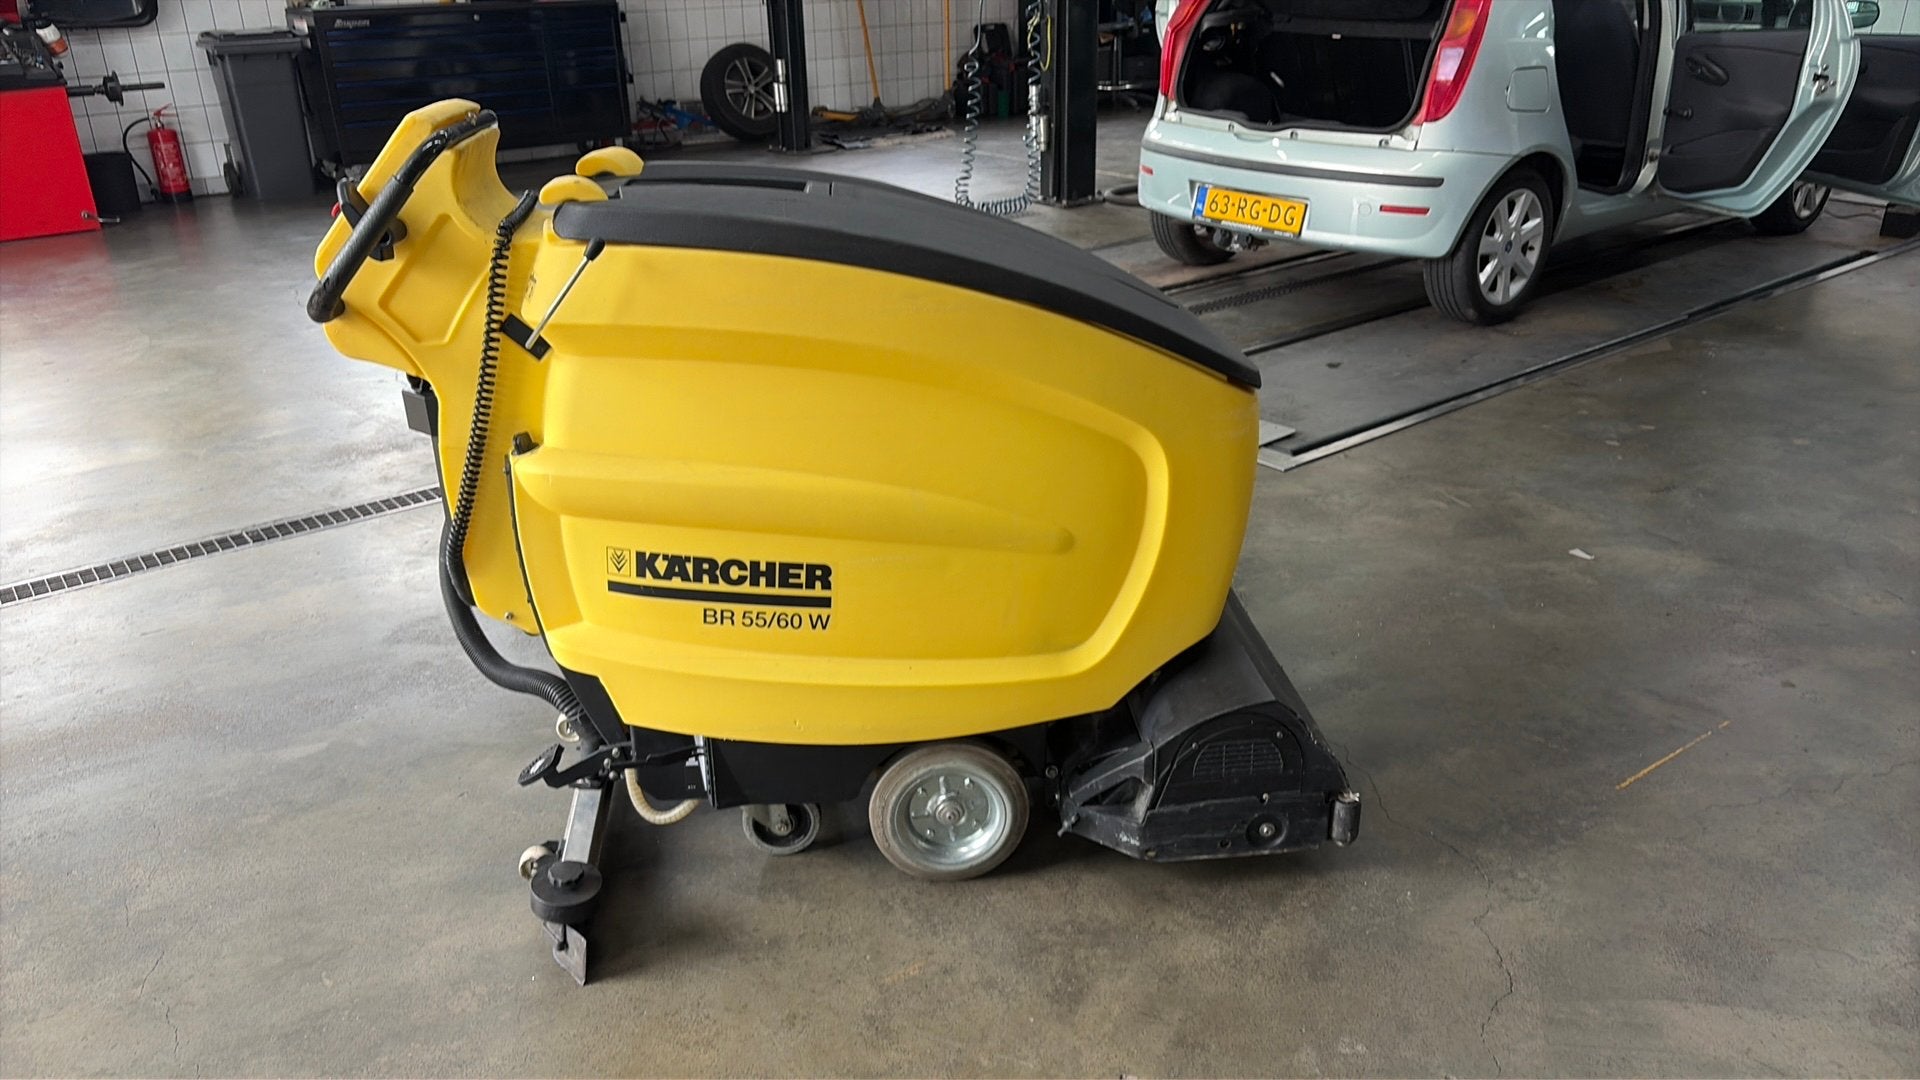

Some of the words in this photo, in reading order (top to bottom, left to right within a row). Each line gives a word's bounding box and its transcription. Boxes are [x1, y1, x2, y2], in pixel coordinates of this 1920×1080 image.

[1209, 193, 1297, 226] 63-RG-DG
[635, 550, 832, 590] KÄRCHER
[703, 608, 735, 626] BR
[741, 610, 803, 630] 55/60
[809, 614, 831, 630] W
